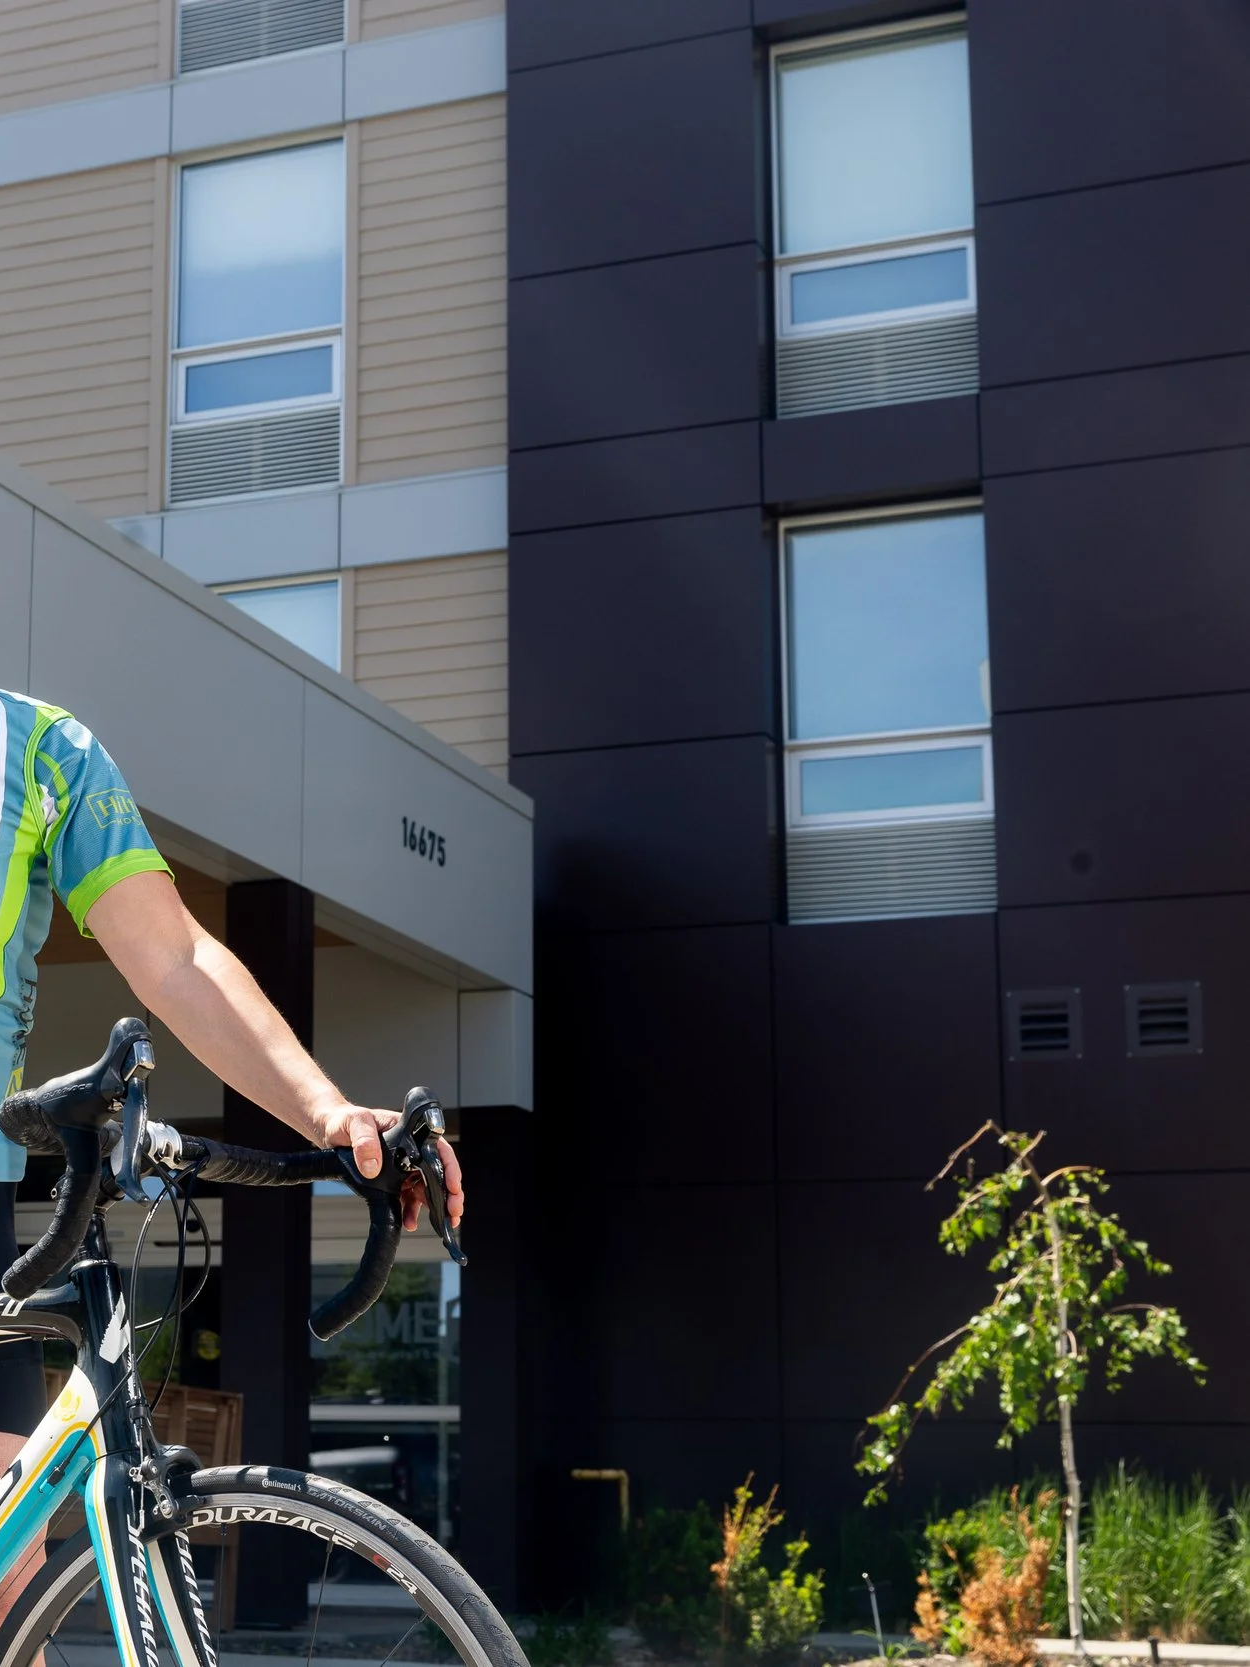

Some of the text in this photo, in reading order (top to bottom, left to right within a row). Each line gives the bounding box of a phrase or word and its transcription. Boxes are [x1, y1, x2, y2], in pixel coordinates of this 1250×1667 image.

[402, 816, 446, 867] 16675
[261, 1477, 296, 1491] Continental
[192, 1506, 358, 1550] DURA-ACE
[306, 1485, 387, 1532] GATORSKIN
[372, 1553, 419, 1595] C24
